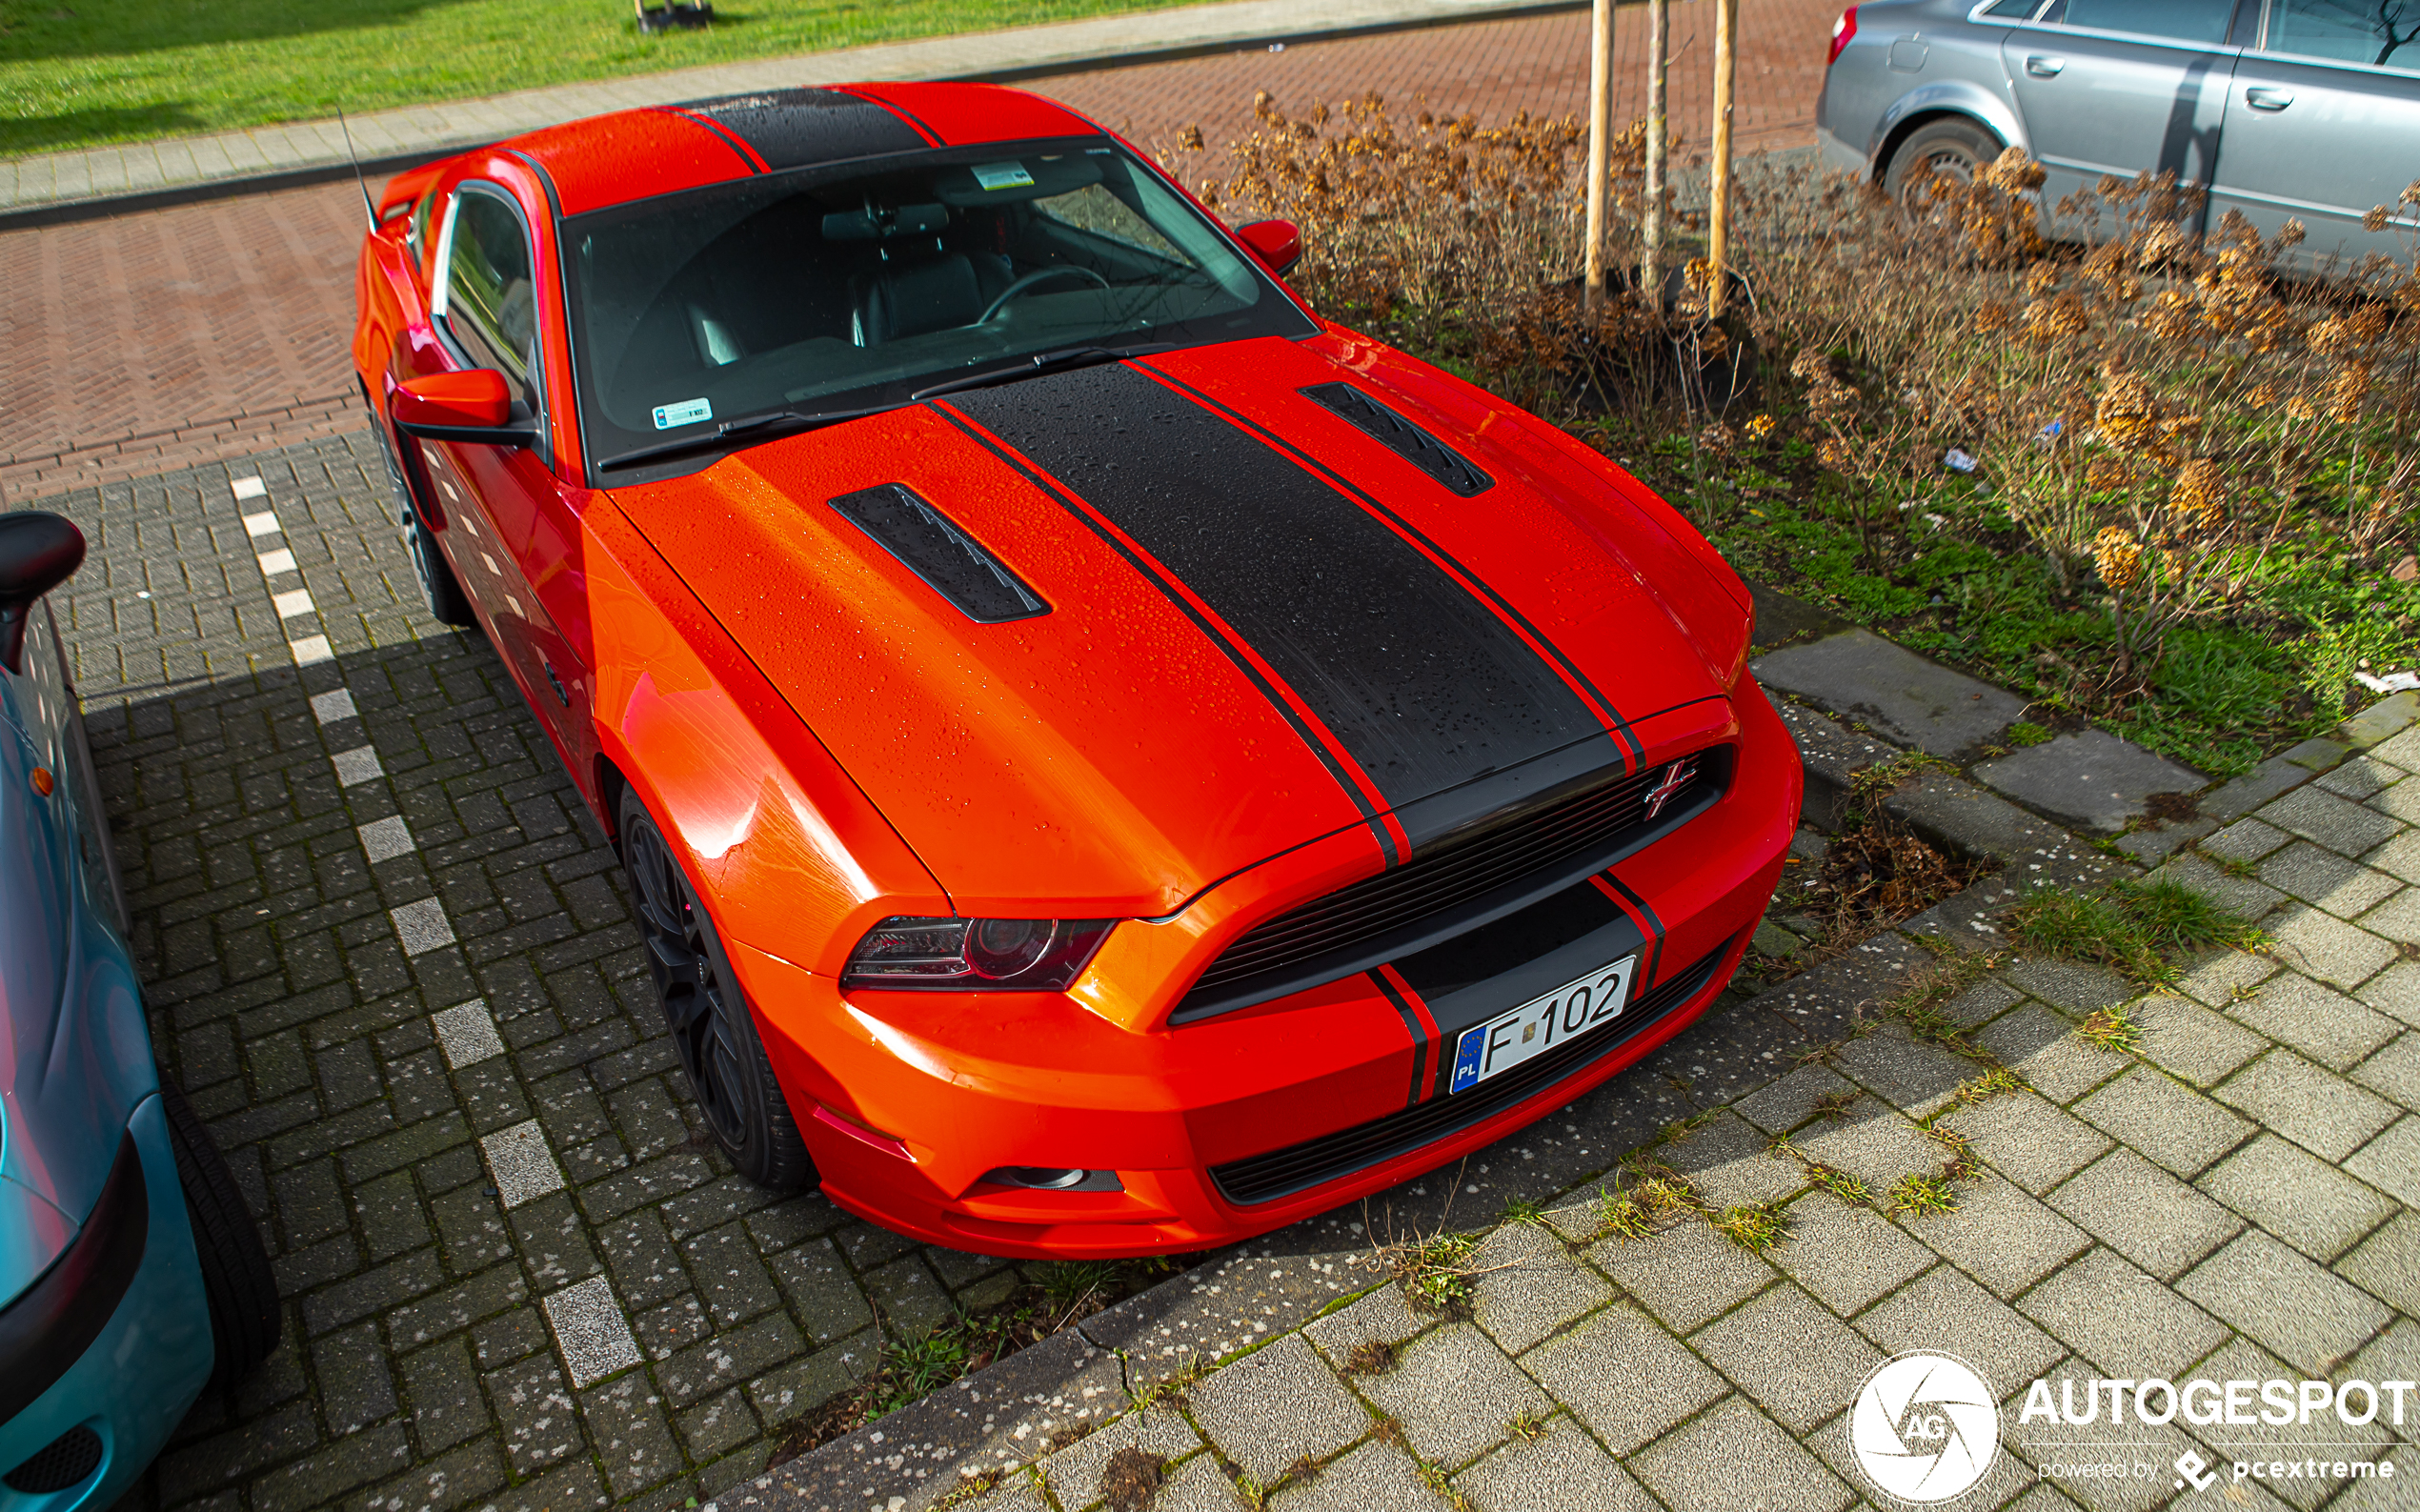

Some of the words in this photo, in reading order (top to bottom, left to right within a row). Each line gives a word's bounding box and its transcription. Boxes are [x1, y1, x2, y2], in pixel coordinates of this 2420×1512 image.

[1483, 1016, 1521, 1074] F
[1540, 973, 1621, 1045] 102
[1458, 1063, 1476, 1080] PL
